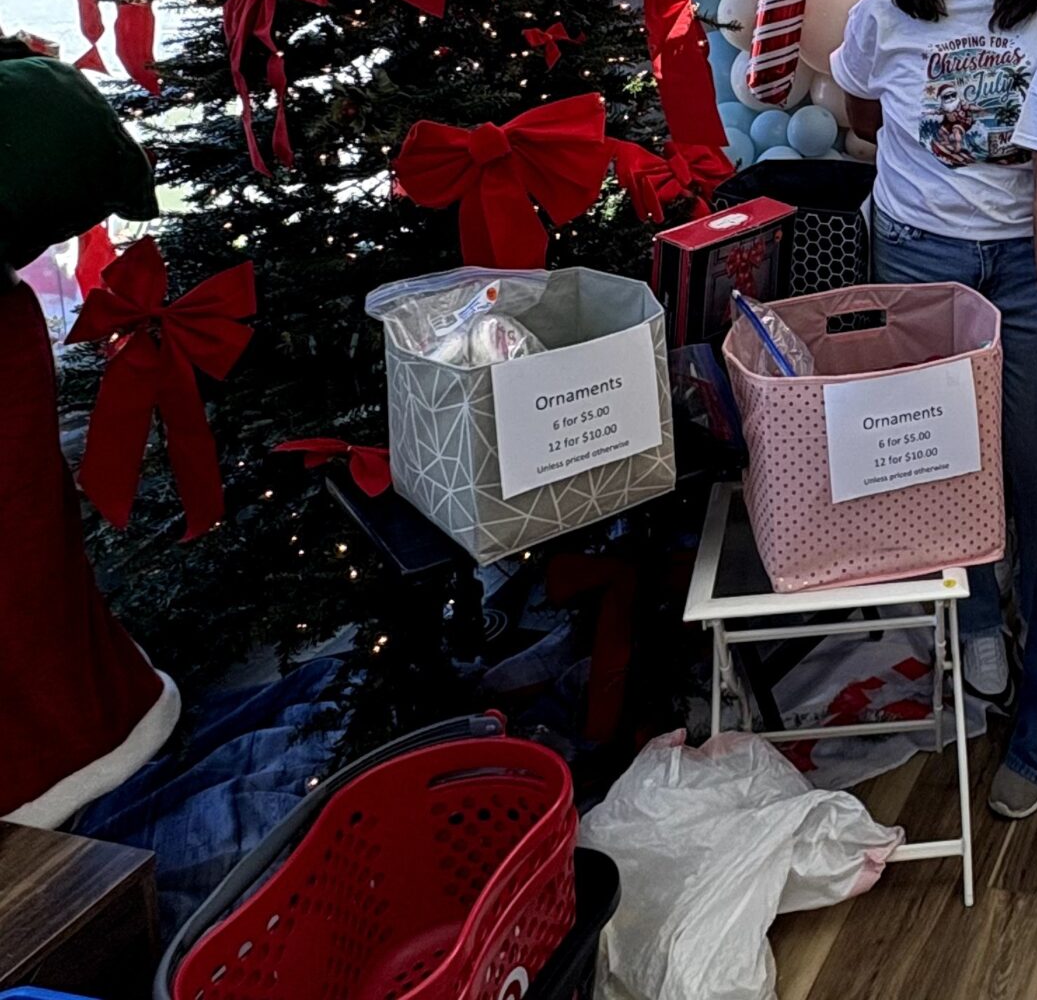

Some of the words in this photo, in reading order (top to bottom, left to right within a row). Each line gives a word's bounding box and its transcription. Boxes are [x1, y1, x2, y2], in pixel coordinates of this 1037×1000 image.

[990, 36, 1008, 48] FOR
[927, 47, 1025, 80] Christmas
[964, 70, 1015, 102] July
[535, 377, 623, 411] Ornaments
[553, 420, 560, 430] 6
[562, 416, 578, 428] for
[580, 405, 610, 423] $5.00
[863, 405, 944, 430] Ornaments
[548, 441, 561, 452] 12
[564, 435, 580, 448] for
[582, 423, 618, 443] $10.00
[878, 439, 885, 448] 6
[888, 436, 901, 447] for
[903, 430, 931, 444] $5.00
[536, 461, 564, 474] Unless
[565, 452, 590, 467] priced
[592, 439, 630, 458] otherwise
[874, 458, 885, 468] 12
[888, 454, 902, 465] for
[905, 447, 938, 462] $10.00
[864, 475, 888, 485] Unless
[889, 470, 912, 482] priced
[914, 463, 949, 476] otherwise
